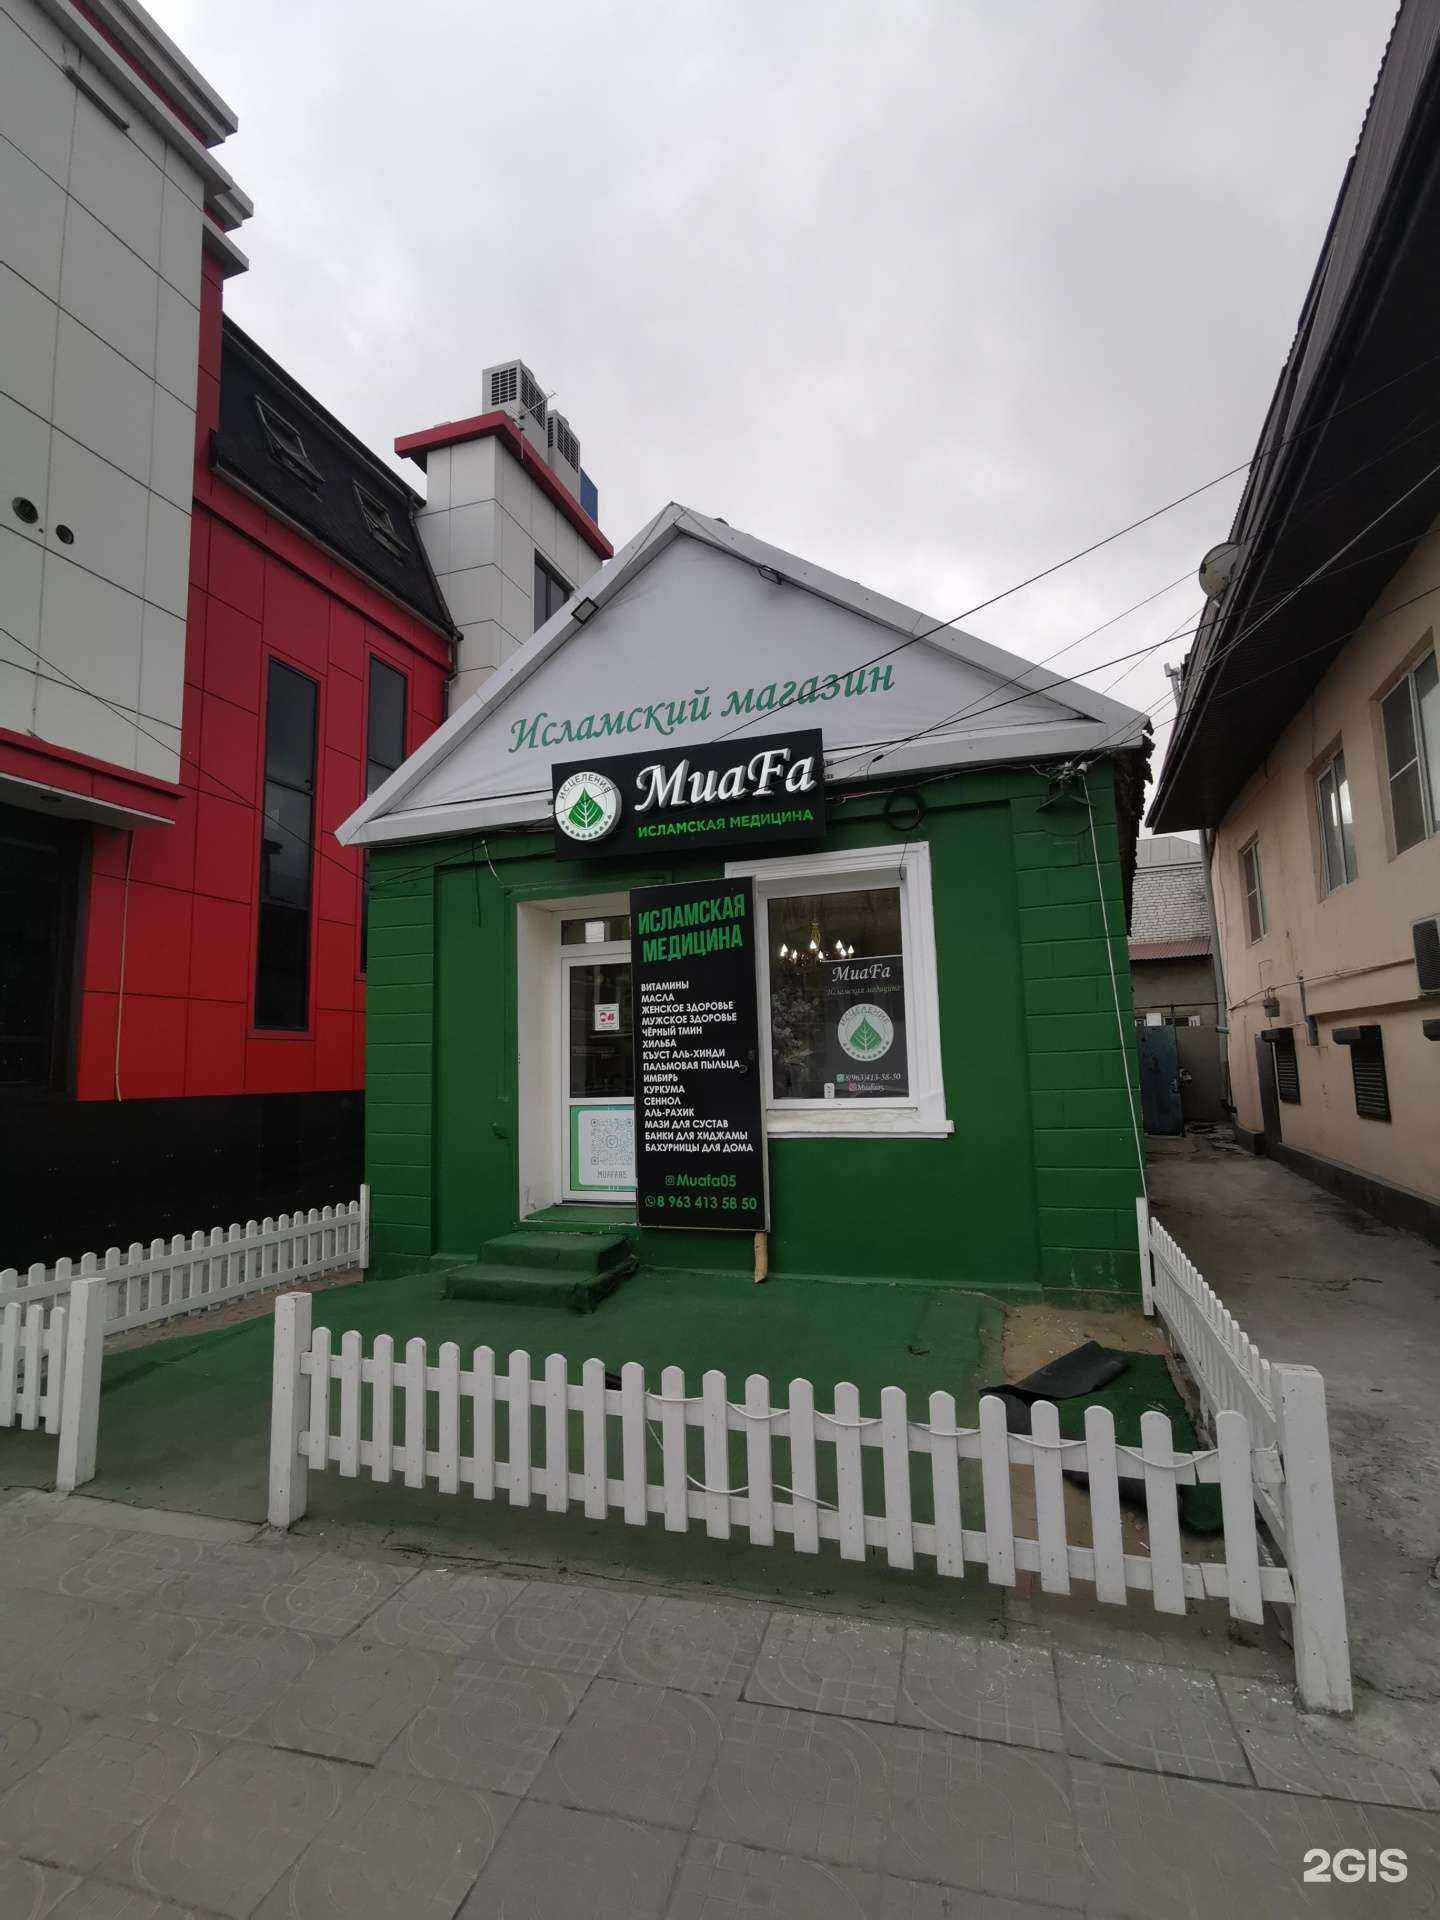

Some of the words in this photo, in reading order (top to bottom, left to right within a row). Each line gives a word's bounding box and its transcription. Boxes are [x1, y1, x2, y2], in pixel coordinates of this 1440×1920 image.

[509, 686, 712, 753] Исламский
[719, 664, 895, 718] магазин
[559, 774, 612, 801] ИСЦЕЛЕНИЕ
[636, 816, 727, 839] ИСЛАМСКАЯ
[729, 807, 815, 830] МЕДИЦИНА
[638, 893, 745, 935] ИСЛАМСКАЯ
[642, 924, 743, 963] МЕДИЦИНА
[641, 980, 689, 992] ВИТАМИНЫ
[641, 993, 675, 1003] МАСЛА
[641, 1003, 685, 1015] ЖЕНСКОЕ
[686, 1001, 735, 1013] ЗДОРОВЬЕ
[641, 1014, 688, 1026] МУЖСКОЕ
[689, 1012, 738, 1024] ЗДОРОВЬЕ
[641, 1025, 676, 1037] ЧЁРНЫЙ
[678, 1026, 703, 1036] ТМИН
[642, 1039, 677, 1049] ХИЛЬБА
[642, 1050, 671, 1060] КЪУСТ
[672, 1048, 726, 1059] АЛЬ-ХИНДИ
[643, 1061, 699, 1071] ПАЛЬМОВАЯ
[701, 1060, 740, 1070] ПЫЛЬЦА
[643, 1073, 679, 1083] ИМБИРЬ
[643, 1085, 686, 1095] КУРКУМА
[643, 1096, 682, 1106] СЕННОЛ
[644, 1108, 695, 1117] АЛЬ-РАХИК
[644, 1120, 670, 1129] МАЗИ
[671, 1120, 691, 1129] ДЛЯ
[692, 1119, 729, 1128] СУСТАВ
[645, 1131, 674, 1140] БАНКИ
[675, 1131, 695, 1141] ДЛЯ
[696, 1131, 748, 1141] ХИДЖАМЫ
[645, 1143, 700, 1152] БАХУРНИЦЫ
[701, 1143, 721, 1152] ДЛЯ
[722, 1143, 754, 1153] ДОМА
[676, 1174, 737, 1187] Muafa05
[657, 1196, 665, 1207] 8
[668, 1196, 691, 1208] 963
[694, 1196, 718, 1209] 413
[721, 1196, 737, 1210] 58
[741, 1197, 757, 1210] 50
